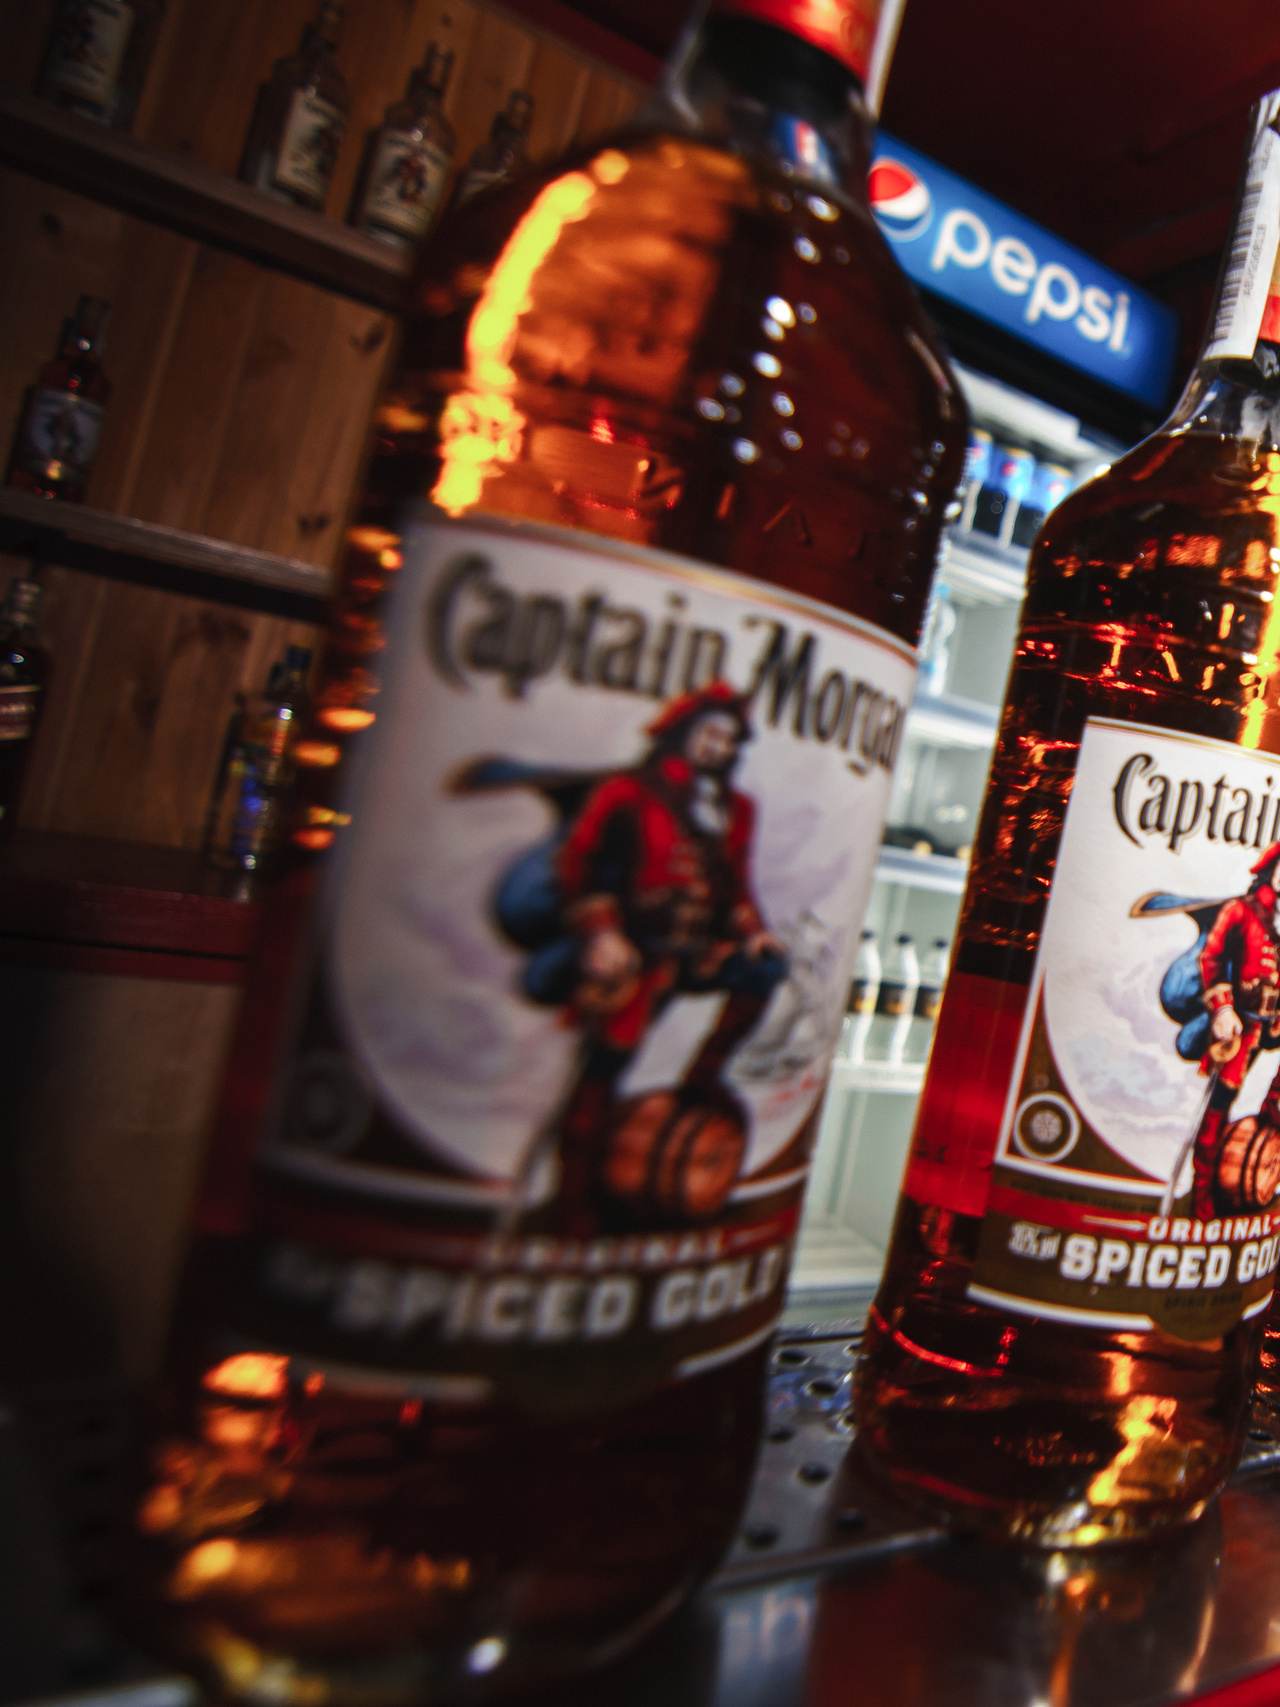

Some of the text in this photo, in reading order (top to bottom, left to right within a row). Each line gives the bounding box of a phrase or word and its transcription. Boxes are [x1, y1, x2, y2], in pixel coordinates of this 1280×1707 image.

[930, 207, 1130, 353] pepsi
[425, 549, 730, 699] Captain
[1060, 1232, 1232, 1290] SPICED
[1147, 1214, 1272, 1243] ORIGINAL
[330, 1256, 638, 1345] SPICED
